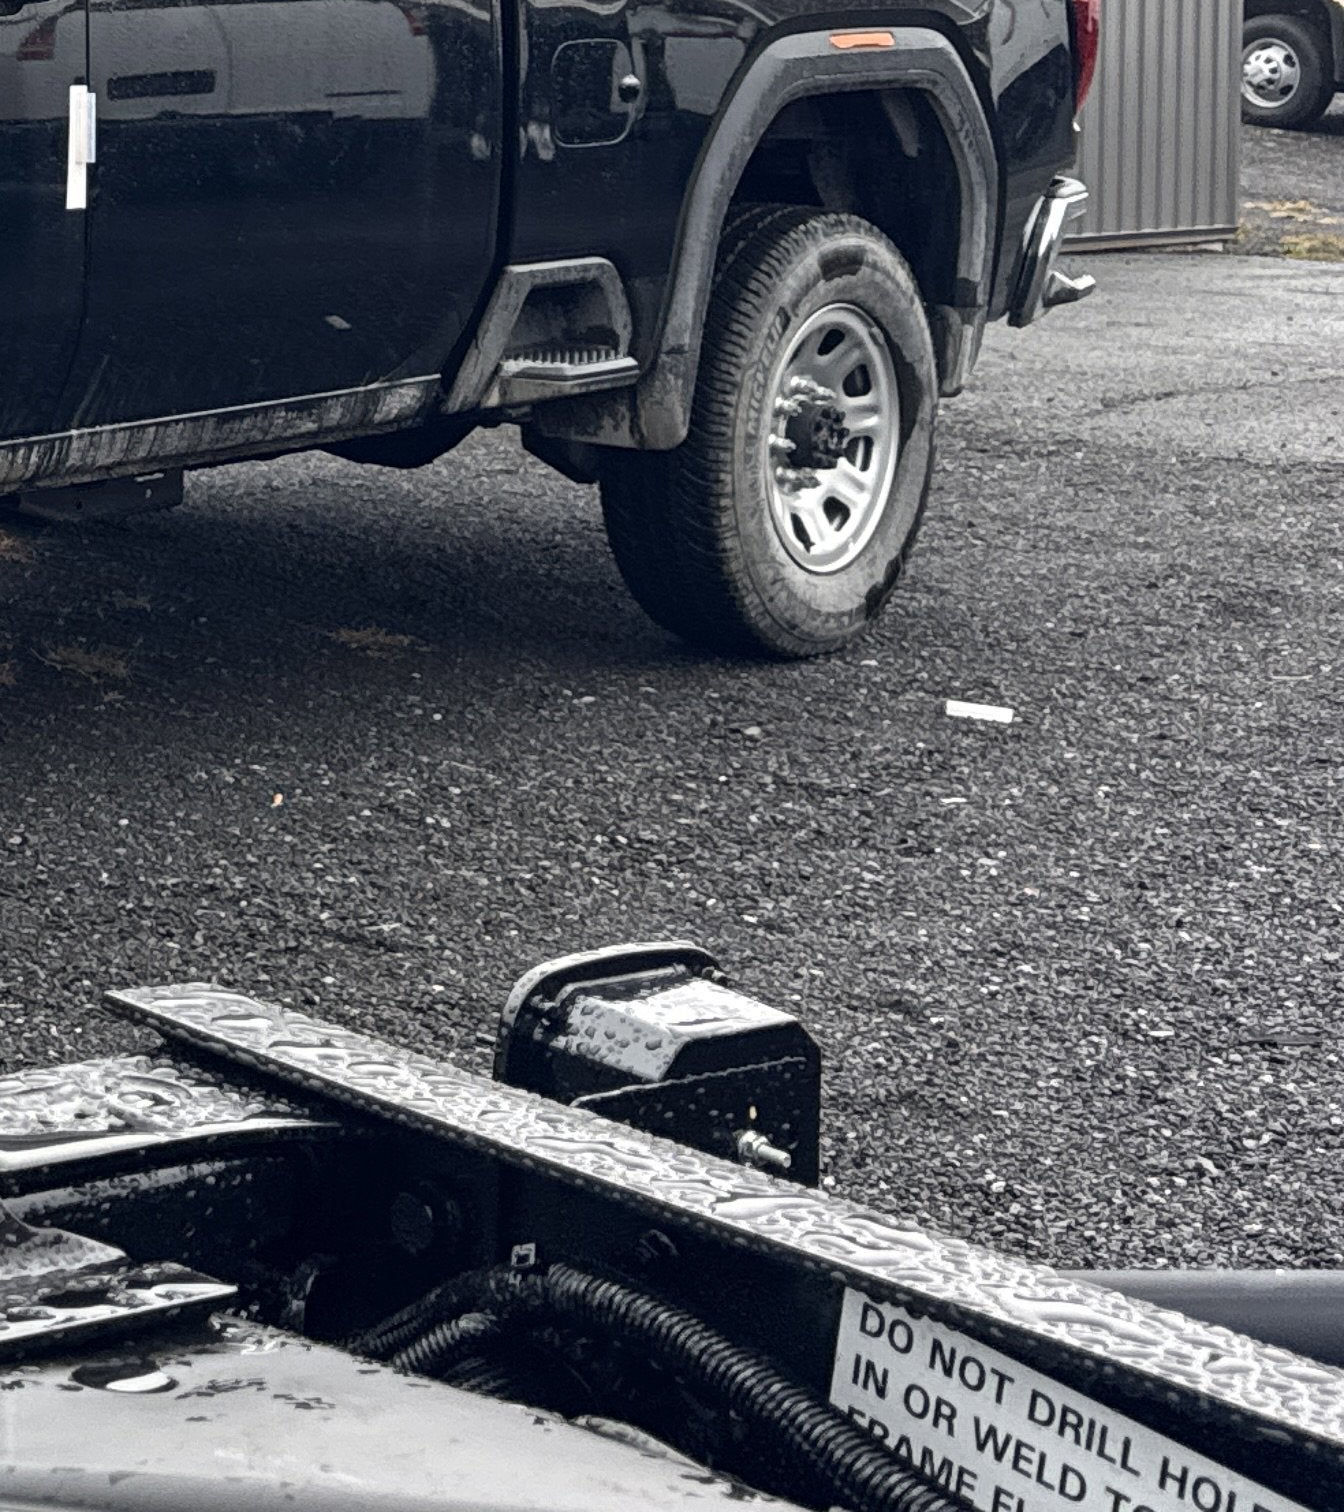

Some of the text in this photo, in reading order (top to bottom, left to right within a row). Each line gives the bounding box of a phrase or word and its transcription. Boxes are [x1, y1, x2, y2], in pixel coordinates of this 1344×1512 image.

[851, 1353, 1157, 1512] IN OR WELD T
[859, 1301, 914, 1355] DO
[928, 1337, 1016, 1406] NOT
[1027, 1388, 1142, 1478] DRILL
